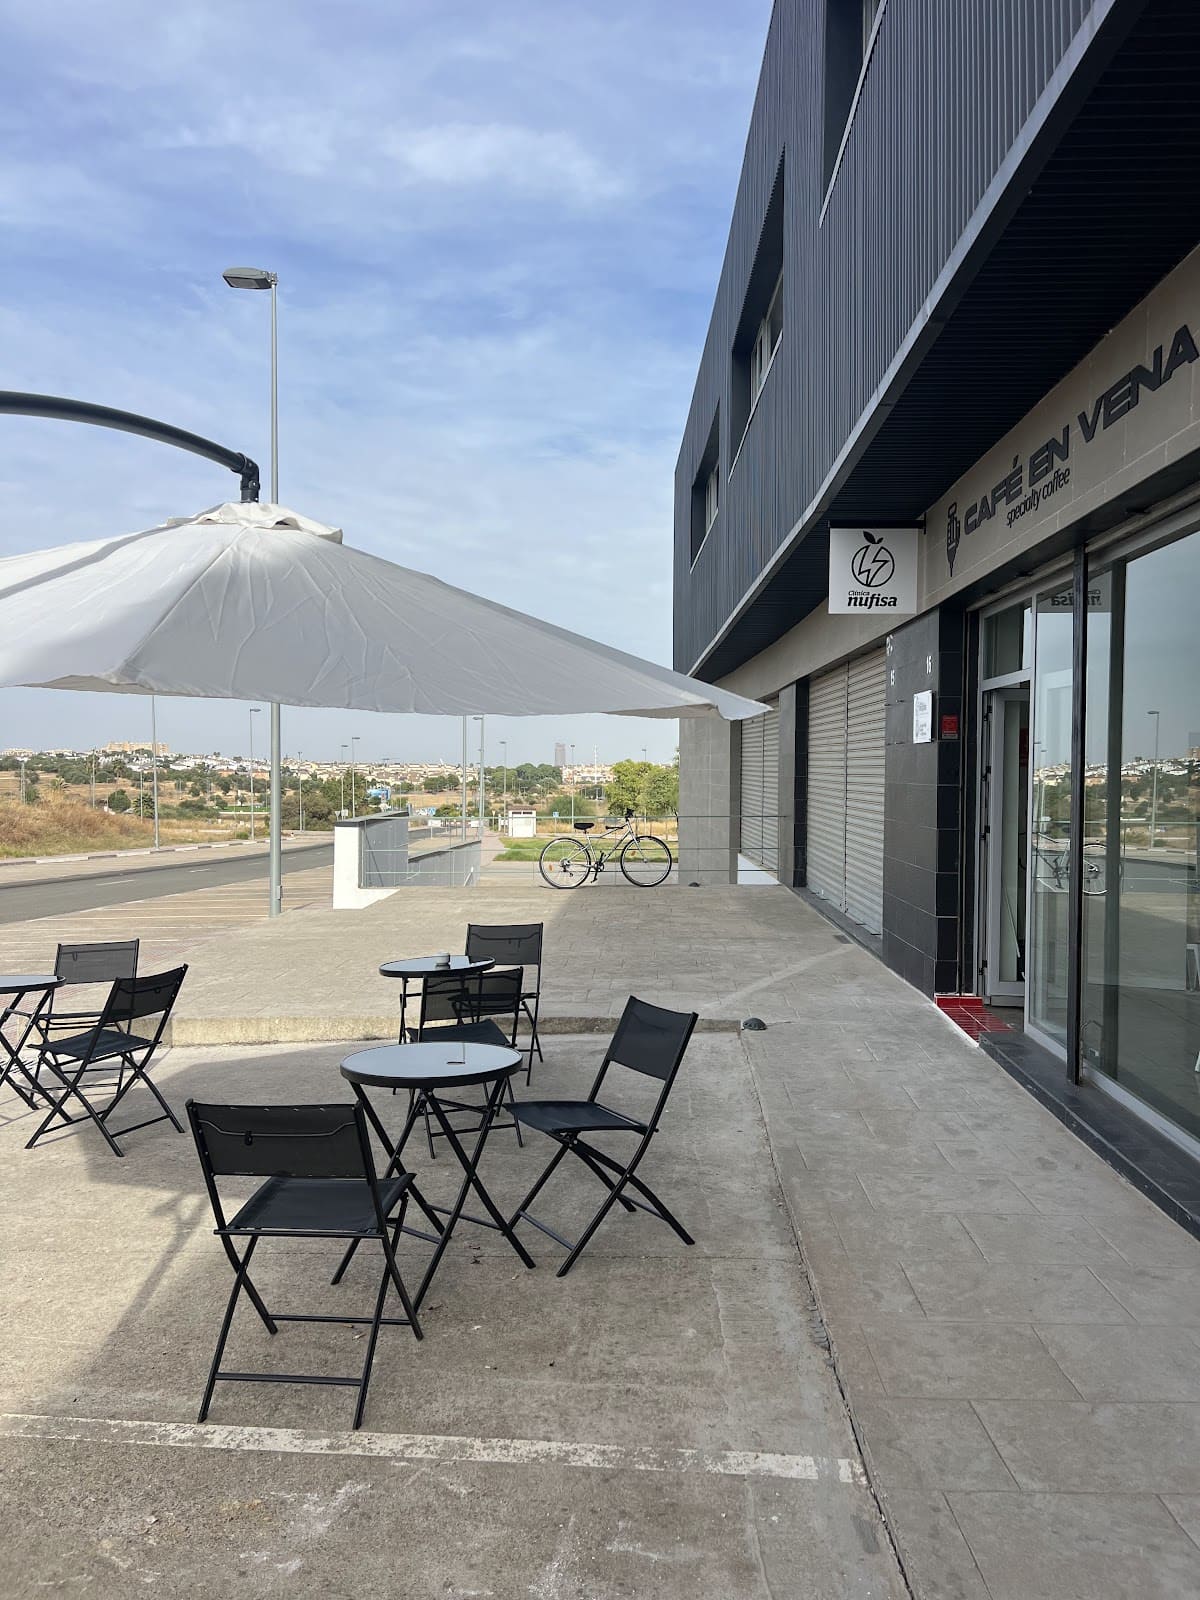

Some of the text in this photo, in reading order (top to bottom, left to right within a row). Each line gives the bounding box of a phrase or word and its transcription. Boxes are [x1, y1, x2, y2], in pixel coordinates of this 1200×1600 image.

[964, 324, 1200, 535] CAFÉ EN VENA
[1006, 468, 1070, 528] specialty coffee
[847, 593, 898, 609] nufisa
